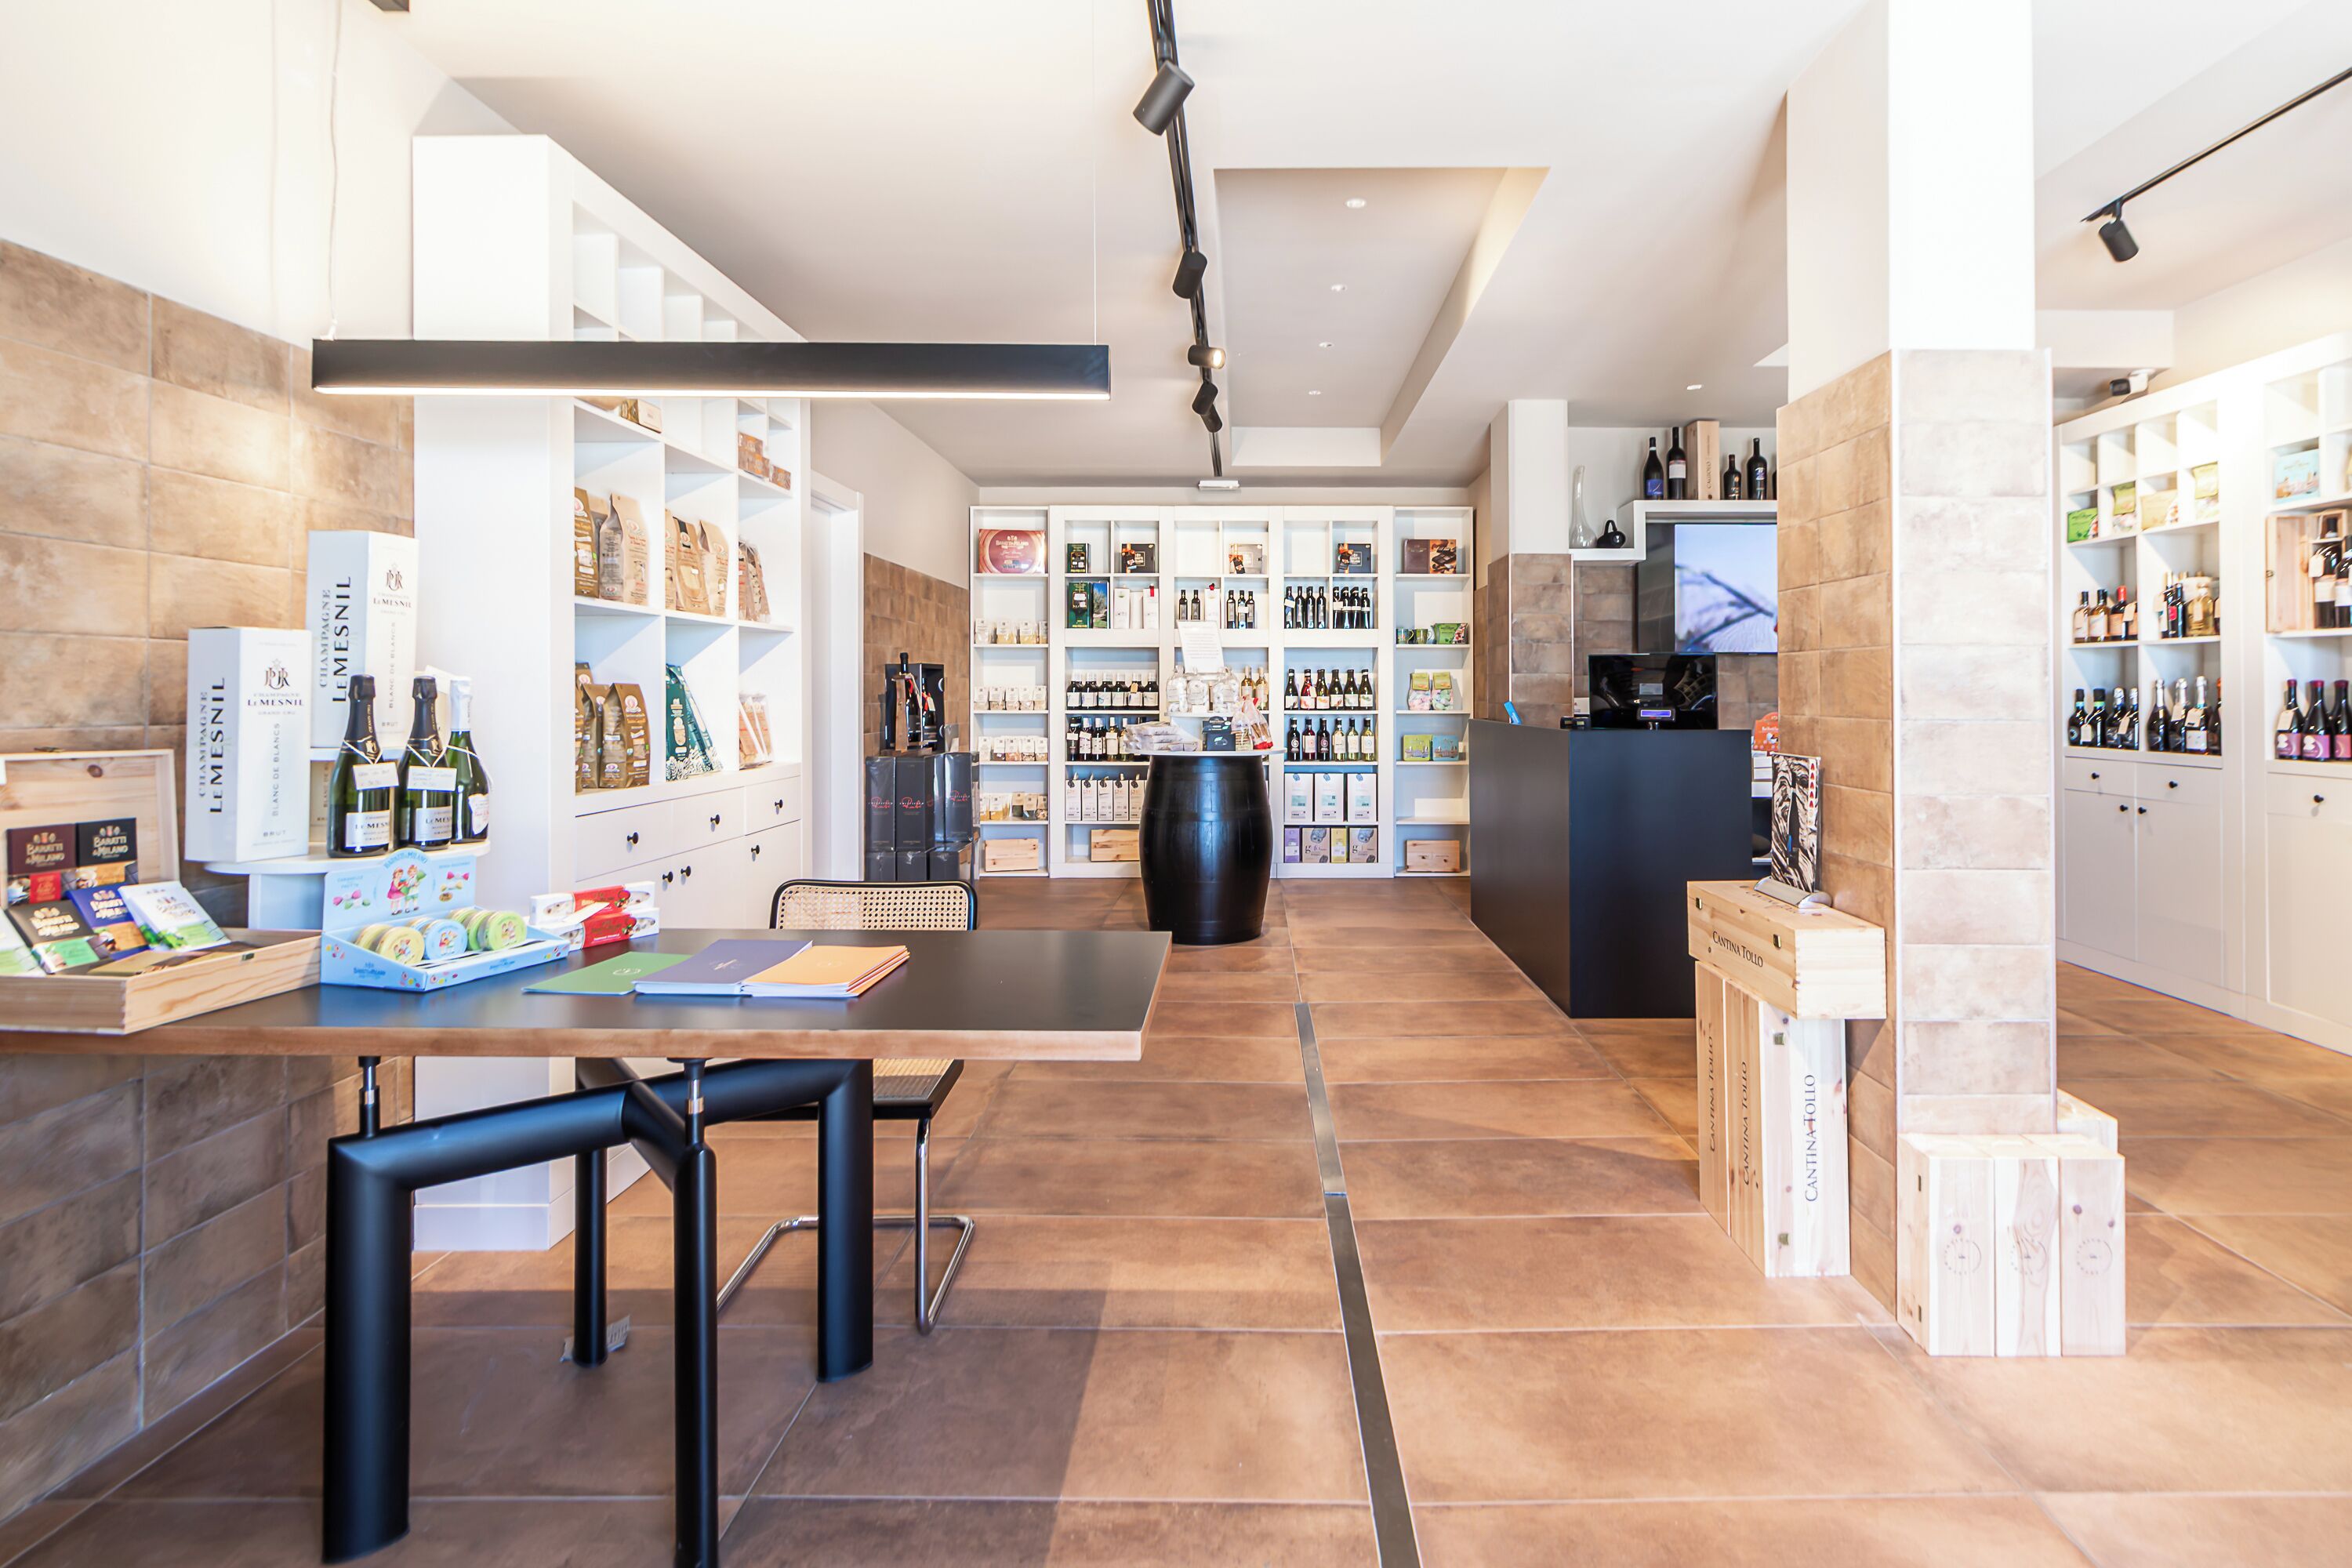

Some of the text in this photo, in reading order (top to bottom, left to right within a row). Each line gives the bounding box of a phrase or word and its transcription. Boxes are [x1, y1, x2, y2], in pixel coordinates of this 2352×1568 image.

[320, 590, 331, 688] CHAMPAGNE
[198, 691, 208, 798] CHAMPAGNE
[273, 767, 279, 779] DE
[26, 842, 64, 855] BARATTI
[94, 835, 127, 848] BARATTI
[1712, 930, 1764, 968] CANTINA TOLLO
[1803, 1074, 1819, 1202] CANTINA TOLLO
